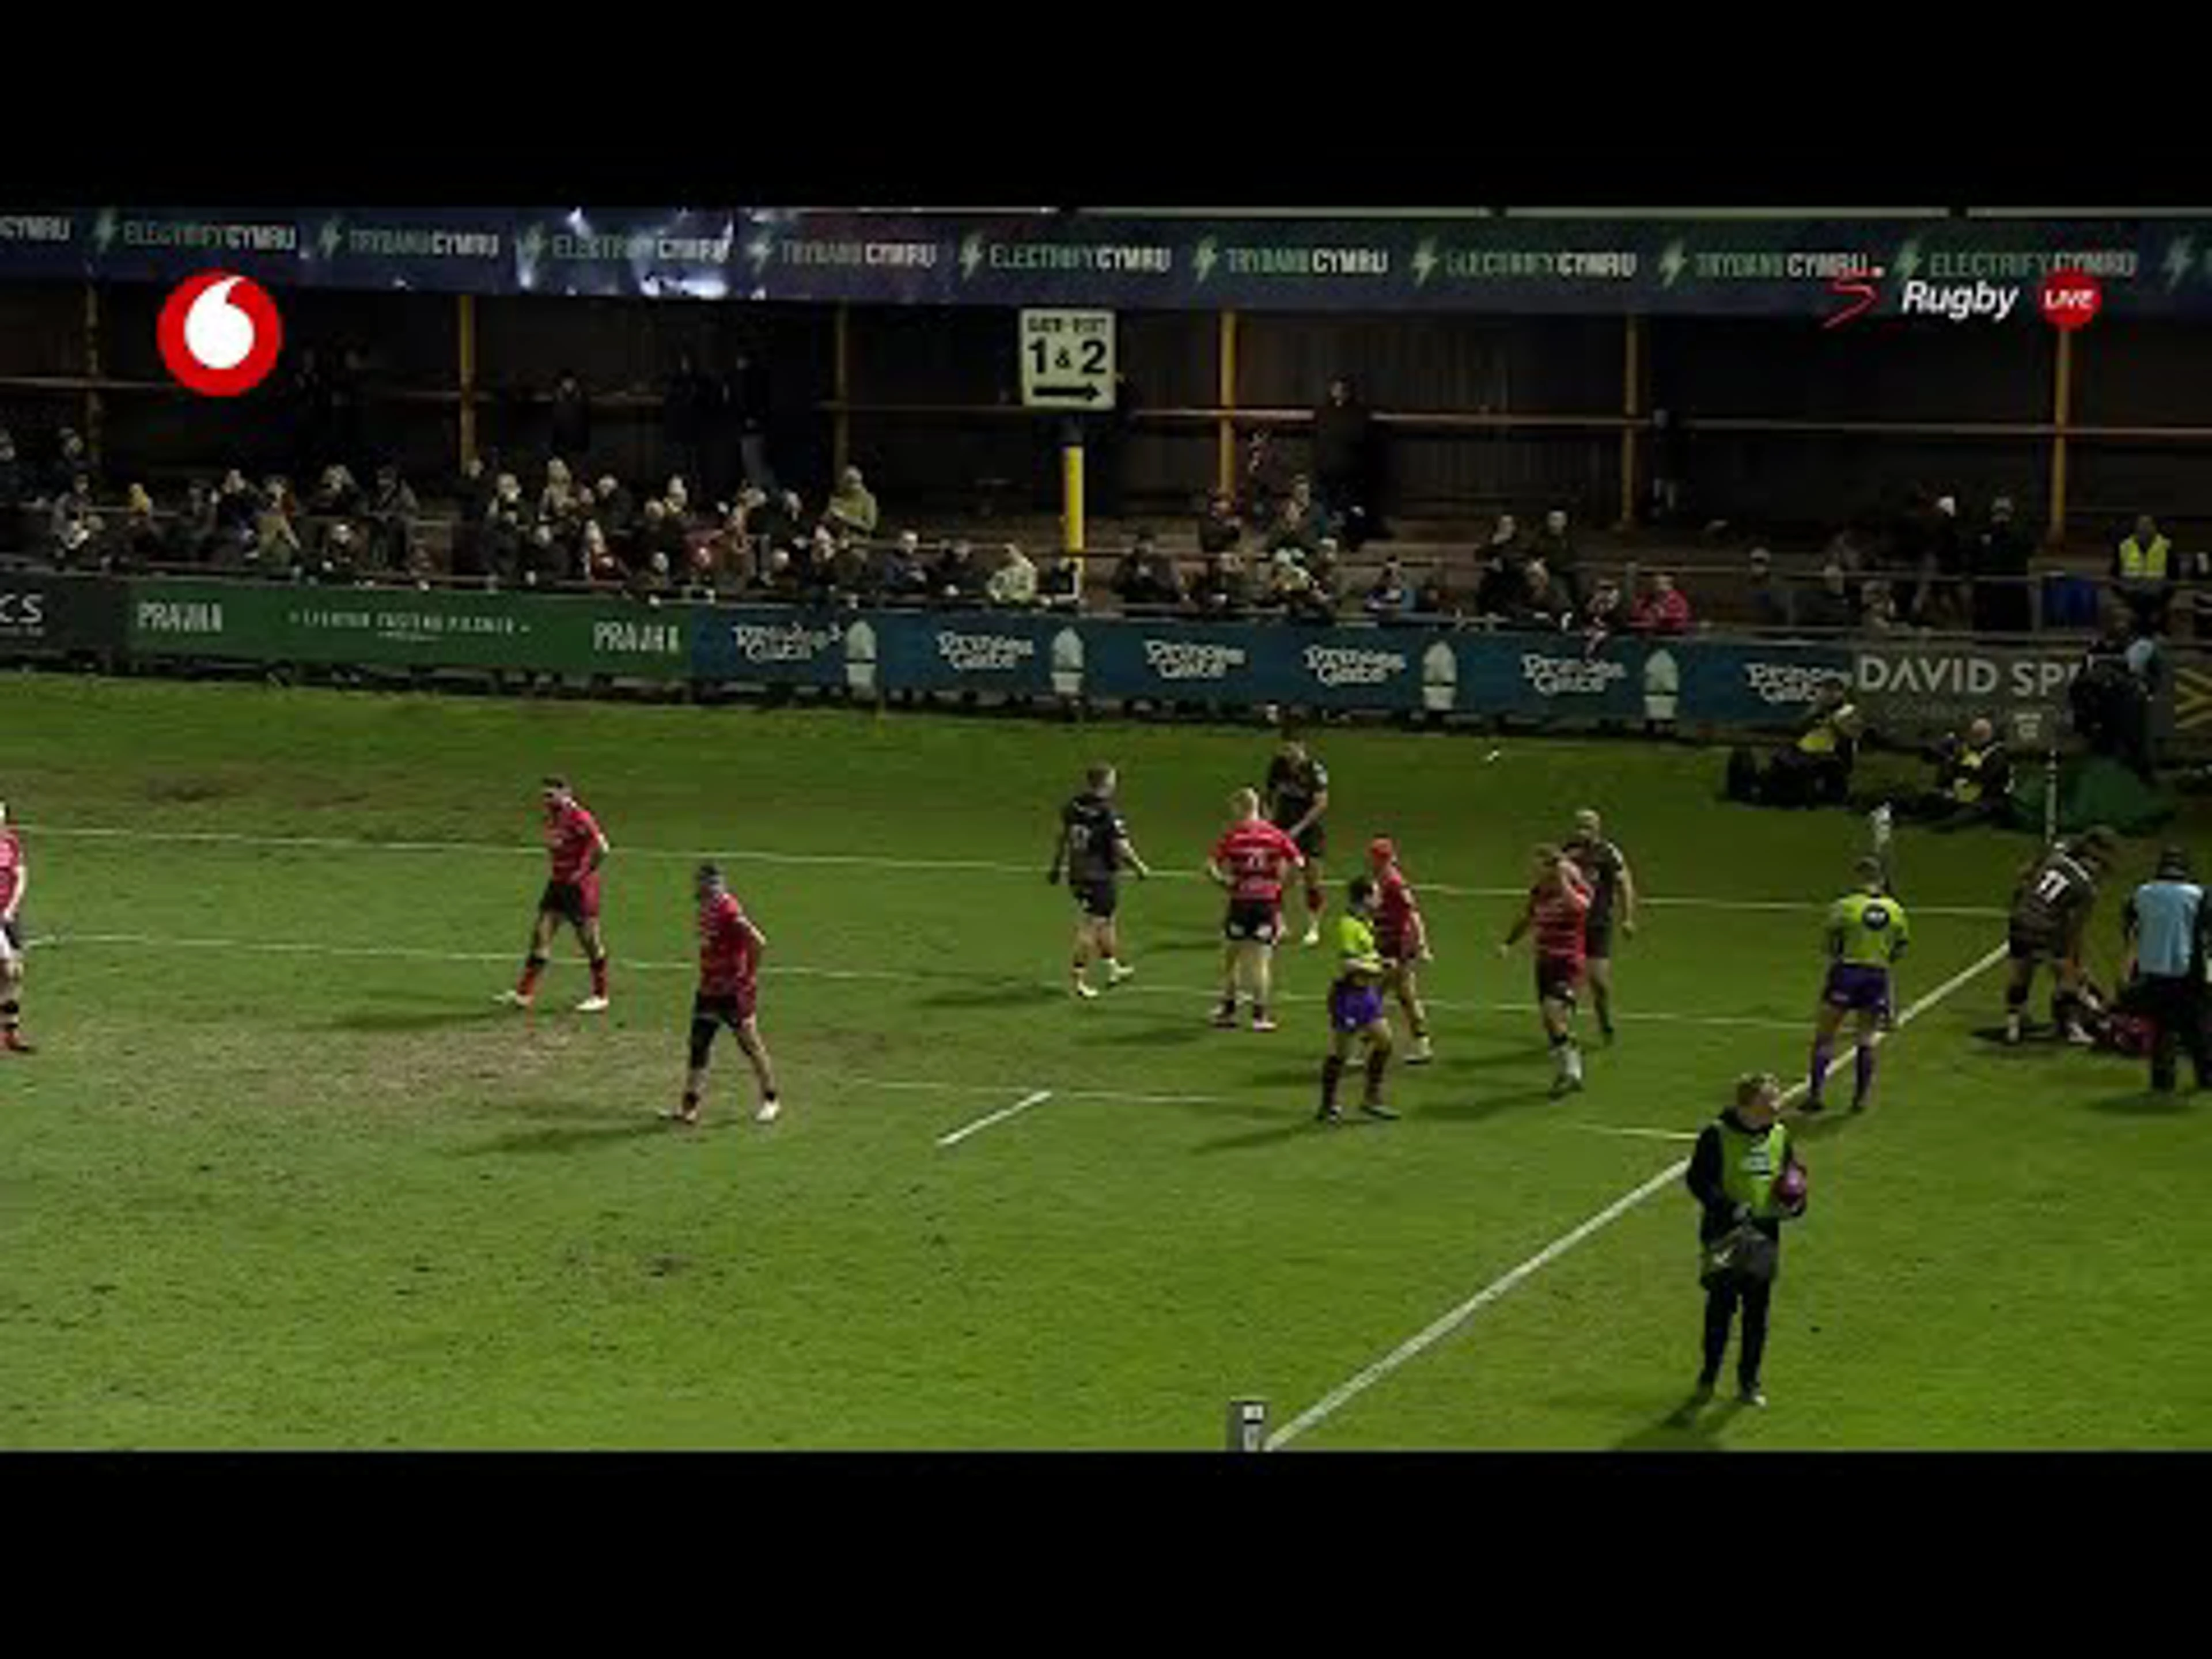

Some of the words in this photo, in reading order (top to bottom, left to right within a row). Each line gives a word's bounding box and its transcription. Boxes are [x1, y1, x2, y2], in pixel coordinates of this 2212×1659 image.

[1028, 338, 1046, 374] 1
[1054, 346, 1073, 370] &
[1081, 339, 1107, 374] 2
[1858, 655, 1999, 694] DAVID
